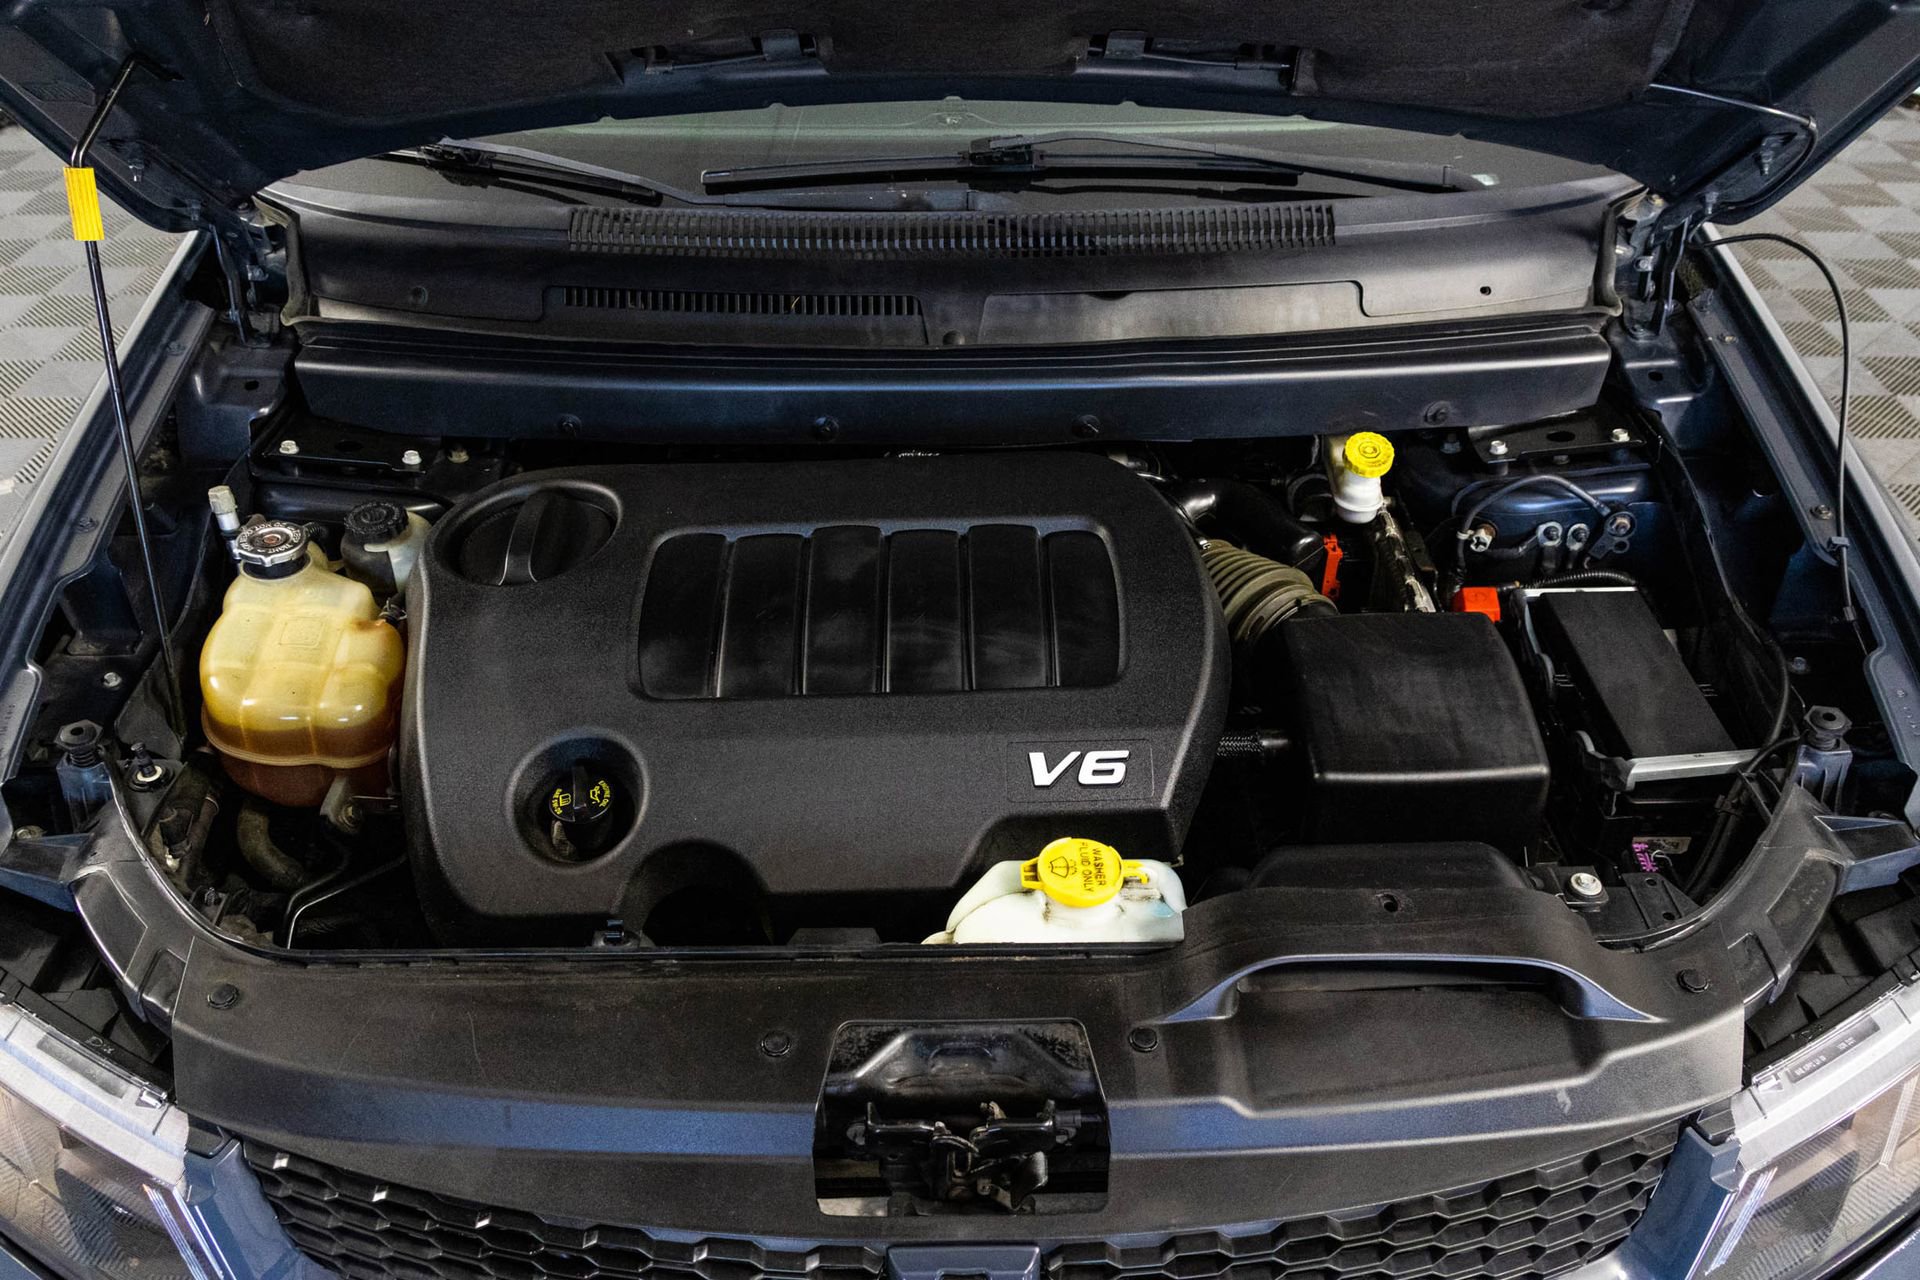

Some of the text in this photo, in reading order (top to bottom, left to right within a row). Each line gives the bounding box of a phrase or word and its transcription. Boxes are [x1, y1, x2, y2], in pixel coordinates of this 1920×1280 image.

[268, 543, 294, 553] TIGHT
[1028, 750, 1130, 787] V6
[599, 798, 609, 807] OIL
[1080, 842, 1095, 892] FLUID ONLY
[1092, 847, 1107, 886] WASHER
